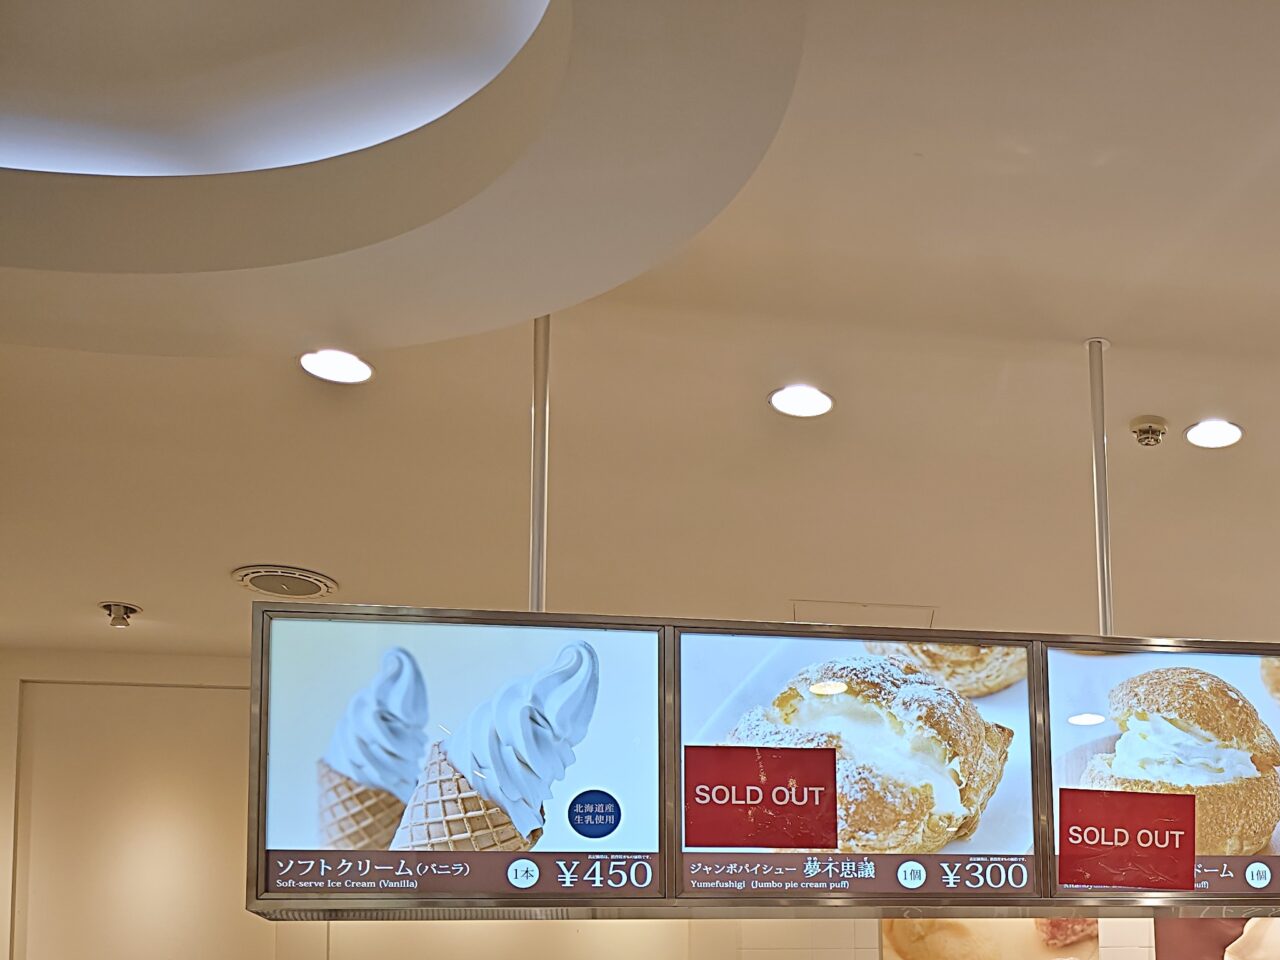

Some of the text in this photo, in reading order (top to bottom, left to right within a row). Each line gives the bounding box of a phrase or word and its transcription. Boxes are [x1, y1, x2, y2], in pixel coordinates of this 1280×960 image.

[695, 785, 825, 806] SOLD OUT
[574, 803, 615, 814] 北海道産
[574, 814, 615, 825] 生乳使用
[1068, 825, 1185, 849] SOLD OUT
[513, 868, 535, 881] 1本
[557, 860, 653, 888] ¥450
[690, 861, 875, 879] ジャンボパイシュー 夢不思議
[902, 869, 922, 882] 1個
[941, 862, 1028, 888] ¥300
[1250, 869, 1267, 881] 1個
[276, 879, 418, 889] Soft-serve Ice Cream (Vanilla)
[690, 880, 849, 890] Yumefushigi (Jumbo pie cream puff)
